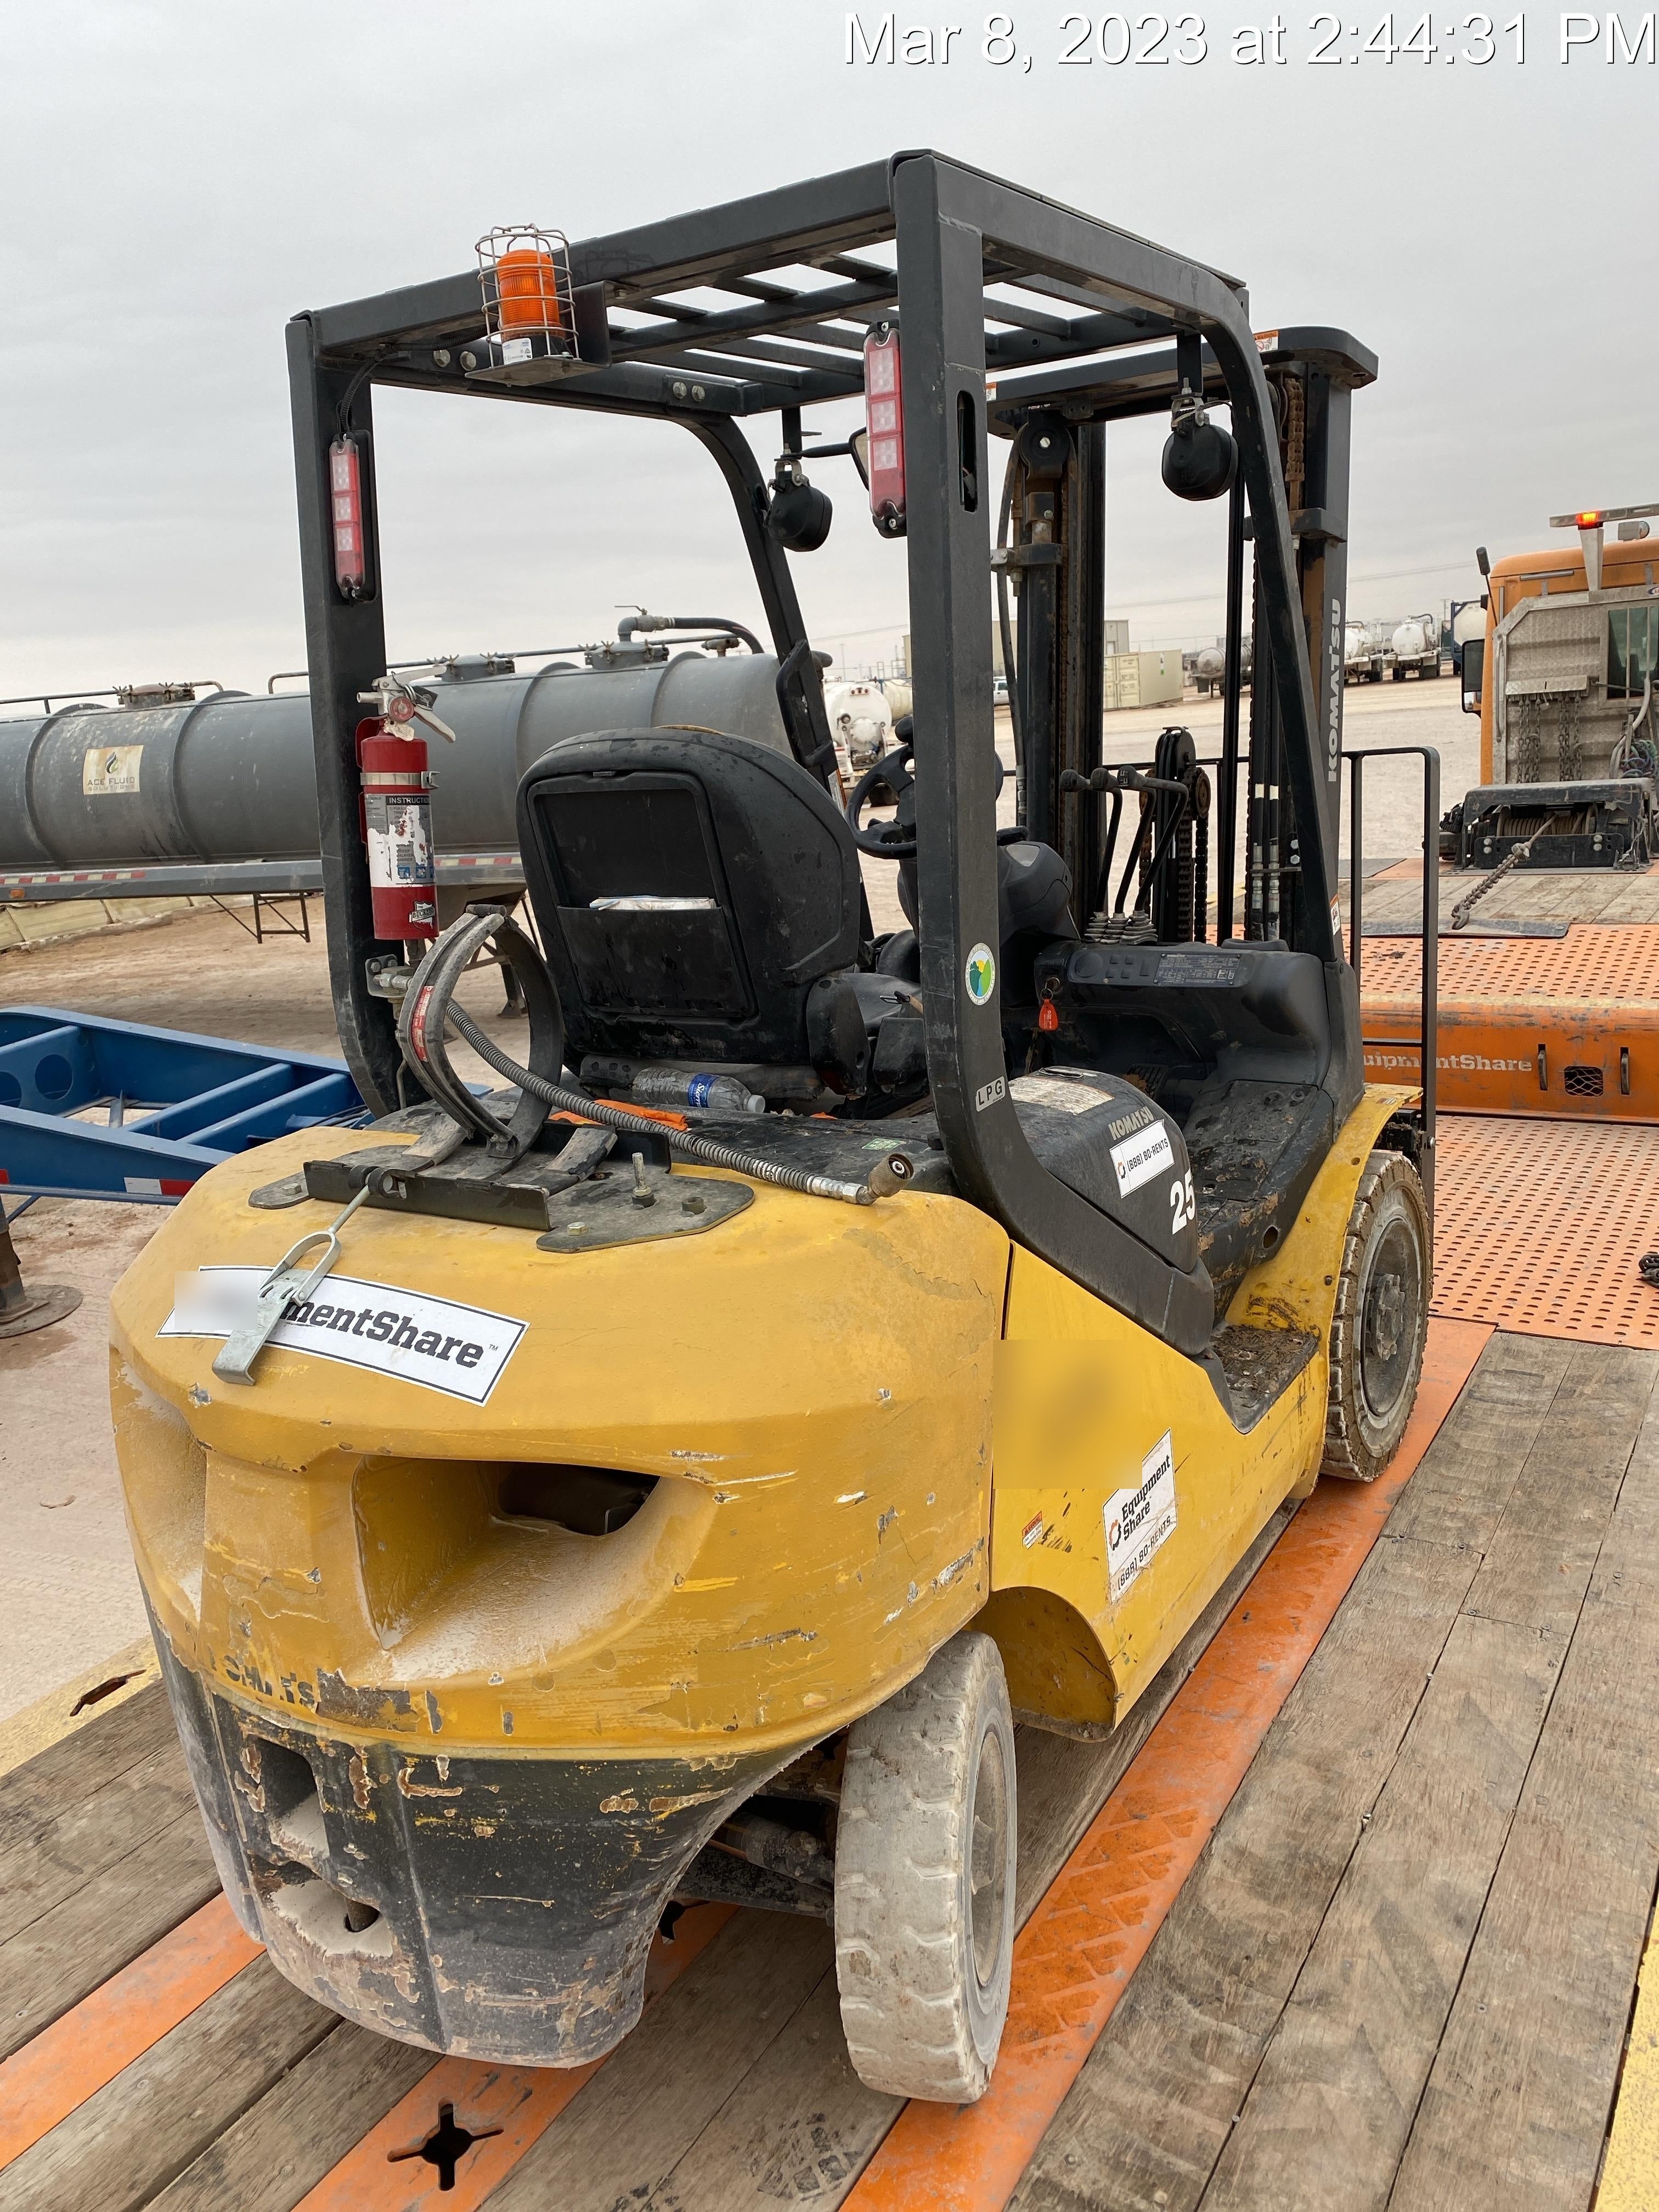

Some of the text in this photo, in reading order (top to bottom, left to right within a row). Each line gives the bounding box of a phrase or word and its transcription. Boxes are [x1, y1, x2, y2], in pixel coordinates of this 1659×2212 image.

[1328, 599, 1341, 782] KOMATSU
[978, 1080, 1002, 1105] LPG
[1108, 1106, 1154, 1141] KOMATSU
[1126, 1138, 1169, 1172] (888) 80-RENTS
[1170, 1167, 1195, 1235] 25
[1121, 1454, 1171, 1522] Equipment
[1123, 1500, 1150, 1541] Share
[1138, 1515, 1171, 1562] 80-RENTS
